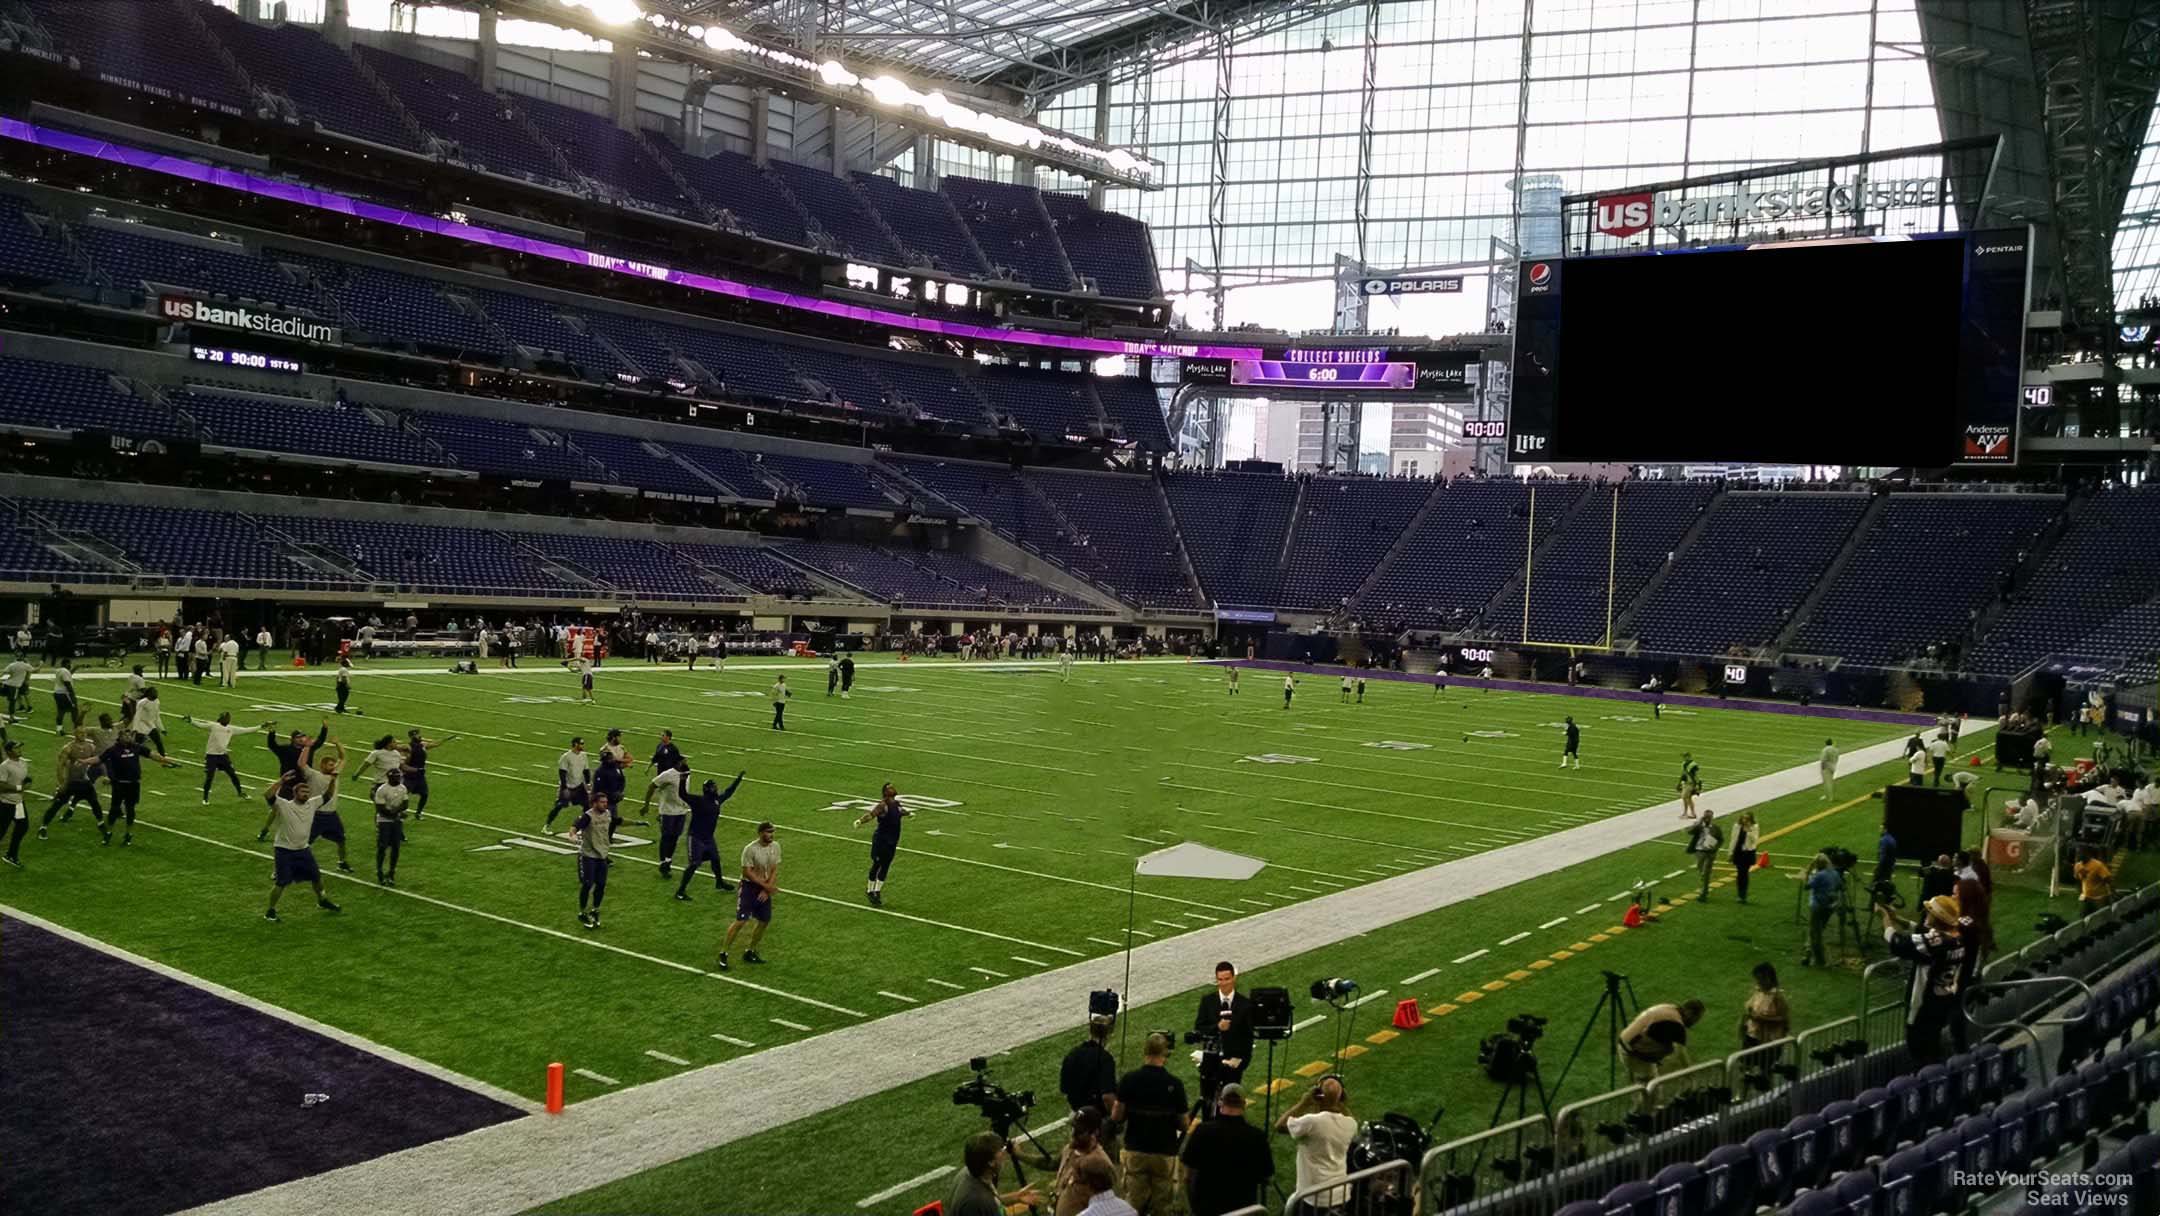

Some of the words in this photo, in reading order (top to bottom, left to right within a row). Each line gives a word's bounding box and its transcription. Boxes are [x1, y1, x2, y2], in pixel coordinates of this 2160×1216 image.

[143, 84, 172, 98] VIKINGS
[1986, 245, 2024, 253] PENTAIR
[588, 252, 625, 270] TODAY'S
[1390, 280, 1459, 291] POLARIS
[1124, 342, 1158, 355] TODAY'S
[210, 350, 224, 361] 20
[232, 353, 266, 368] 90:00
[1291, 350, 1333, 362] COLLECT
[1338, 351, 1380, 362] SHIELDS
[1309, 368, 1338, 380] 6:00
[2025, 388, 2049, 404] 40
[1465, 422, 1505, 436] 90:00
[1966, 425, 2009, 433] Andersen
[1514, 434, 1546, 454] Lite
[1727, 668, 1745, 681] 40
[2007, 842, 2020, 858] G
